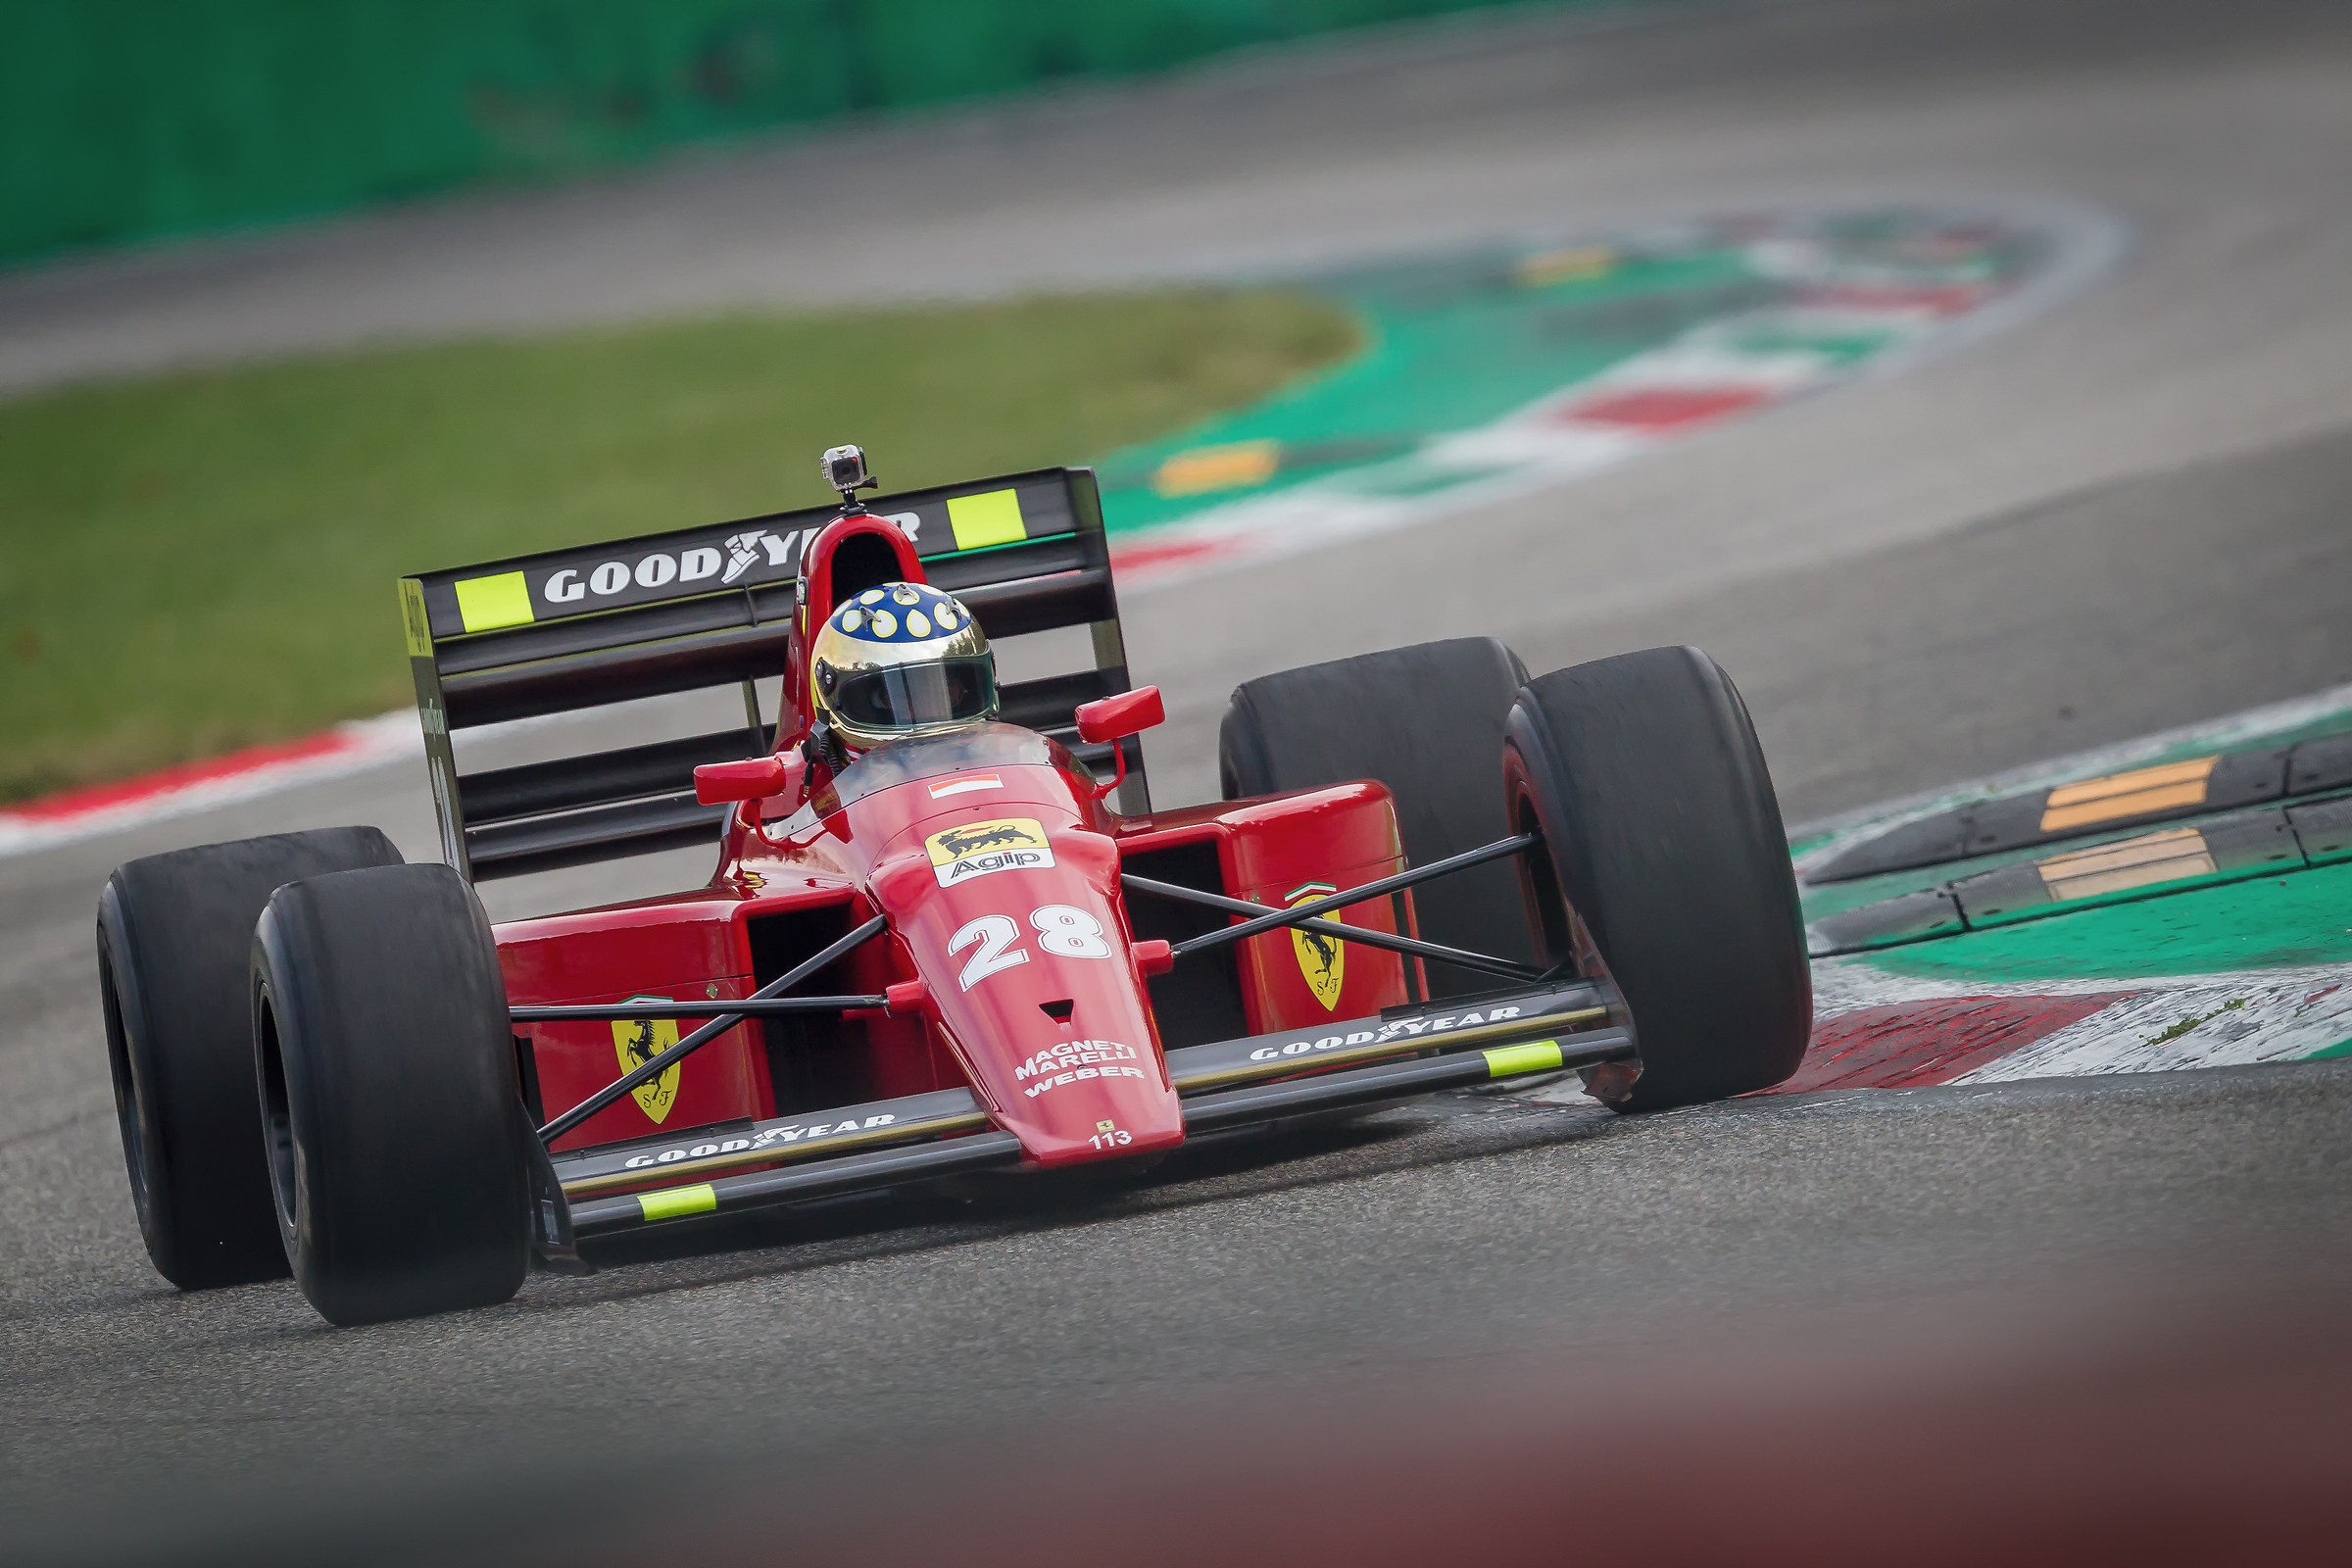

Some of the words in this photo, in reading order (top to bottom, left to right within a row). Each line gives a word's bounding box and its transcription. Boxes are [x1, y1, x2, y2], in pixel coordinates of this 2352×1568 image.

[544, 511, 920, 604] GOODYR
[950, 852, 1041, 880] Agip
[948, 904, 1112, 993] 28
[1250, 1006, 1520, 1061] GOODYEAR
[1014, 1040, 1137, 1081] MAGNETI
[1014, 1049, 1137, 1081] MARELLI
[1024, 1066, 1145, 1098] WEBER
[624, 1113, 895, 1169] GOODYEAR
[1088, 1130, 1133, 1151] 113
